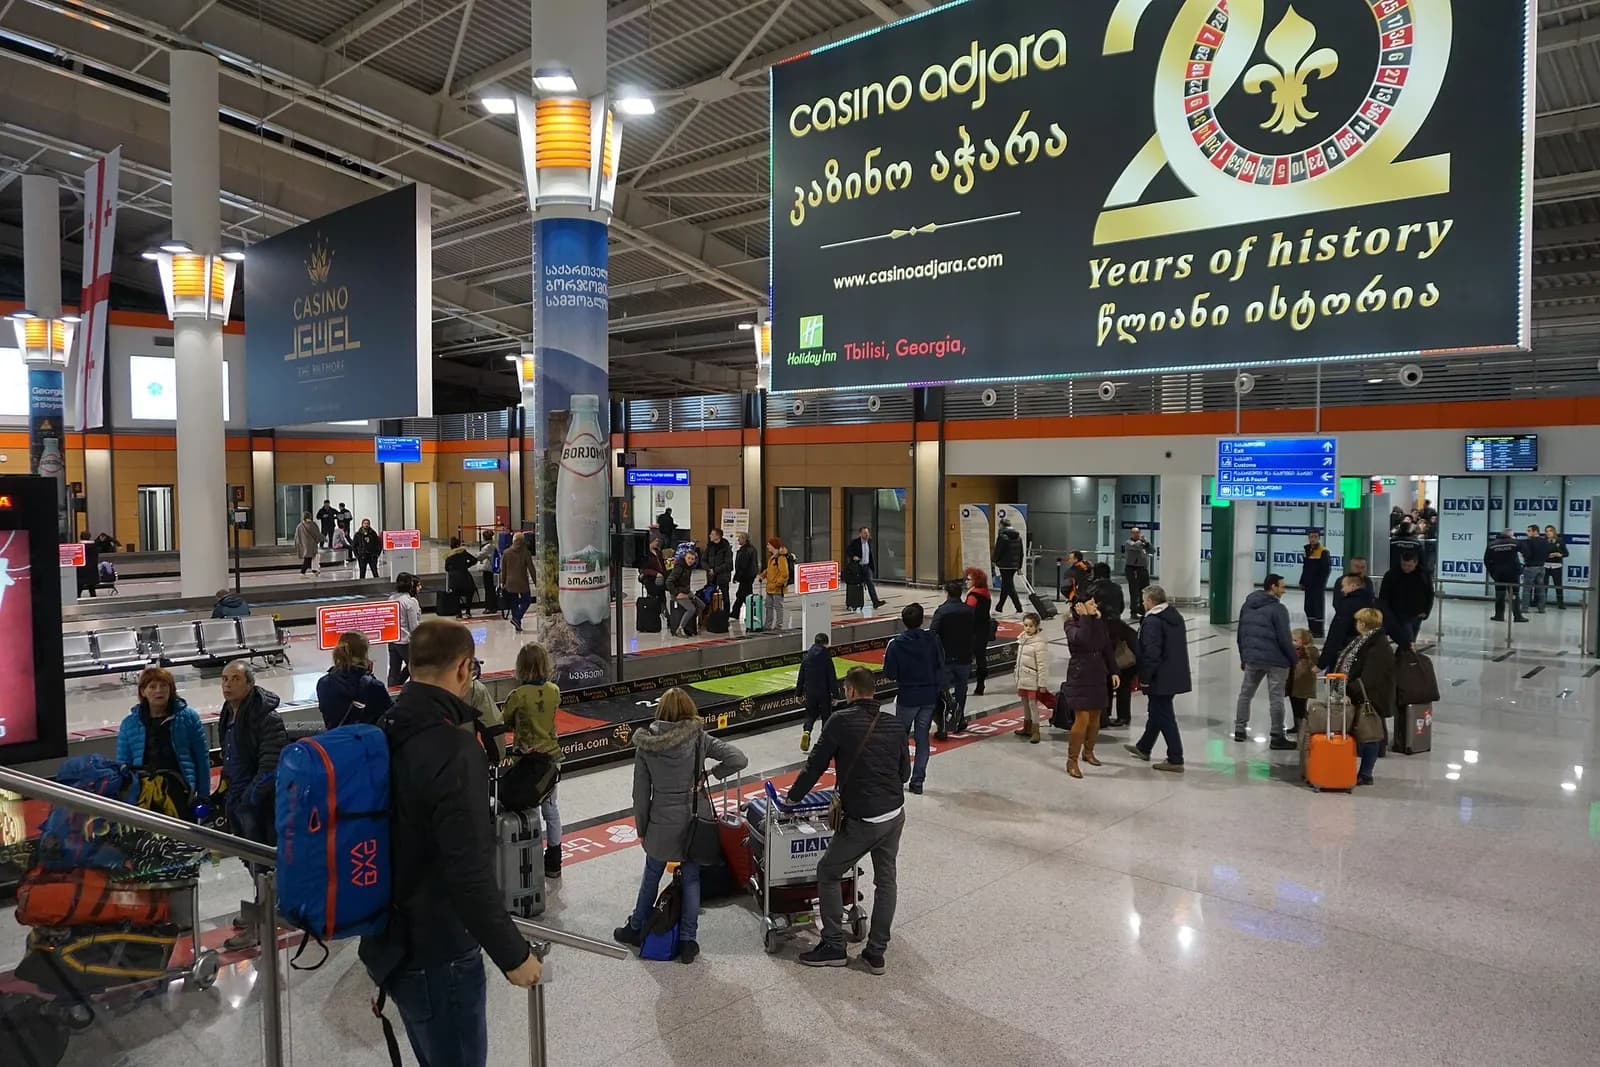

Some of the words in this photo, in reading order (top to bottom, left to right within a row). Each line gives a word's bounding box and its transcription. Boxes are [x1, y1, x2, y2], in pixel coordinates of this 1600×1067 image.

[1387, 13, 1404, 28] 17
[1204, 31, 1216, 41] 7
[1389, 31, 1405, 47] 34
[1196, 46, 1210, 60] 29
[1191, 63, 1205, 76] 18
[1385, 69, 1401, 83] 27
[789, 75, 913, 137] casino
[919, 28, 1067, 110] adjara
[1190, 79, 1203, 92] 22
[1376, 87, 1393, 102] 13
[1365, 103, 1384, 120] 36
[1356, 121, 1370, 134] 11
[1205, 138, 1220, 153] 20
[1340, 132, 1357, 150] 30
[1327, 146, 1338, 159] 8
[790, 146, 913, 226] კაზინო
[930, 110, 1068, 195] აჭარა
[1229, 155, 1243, 170] 33
[1243, 159, 1256, 174] 16
[1309, 153, 1324, 169] 23
[1258, 162, 1272, 177] 24
[1277, 164, 1286, 177] 5
[1292, 162, 1305, 176] 10
[1089, 253, 1194, 289] Years
[1209, 235, 1258, 283] of
[1266, 218, 1454, 267] history
[833, 252, 1004, 289] www.casinoadjara.com
[293, 286, 348, 320] CASINO
[1096, 292, 1230, 347] წლიანი
[1245, 274, 1441, 331] ისტორია
[284, 316, 360, 361] JEWEL
[844, 342, 890, 361] Tbilisi,
[895, 334, 967, 360] Georgia,
[786, 352, 821, 366] Holiday
[821, 350, 837, 362] Inn
[1444, 499, 1485, 510] TAV
[1514, 499, 1558, 511] TAV
[1452, 533, 1473, 541] EXIT
[1442, 561, 1483, 573] TAV
